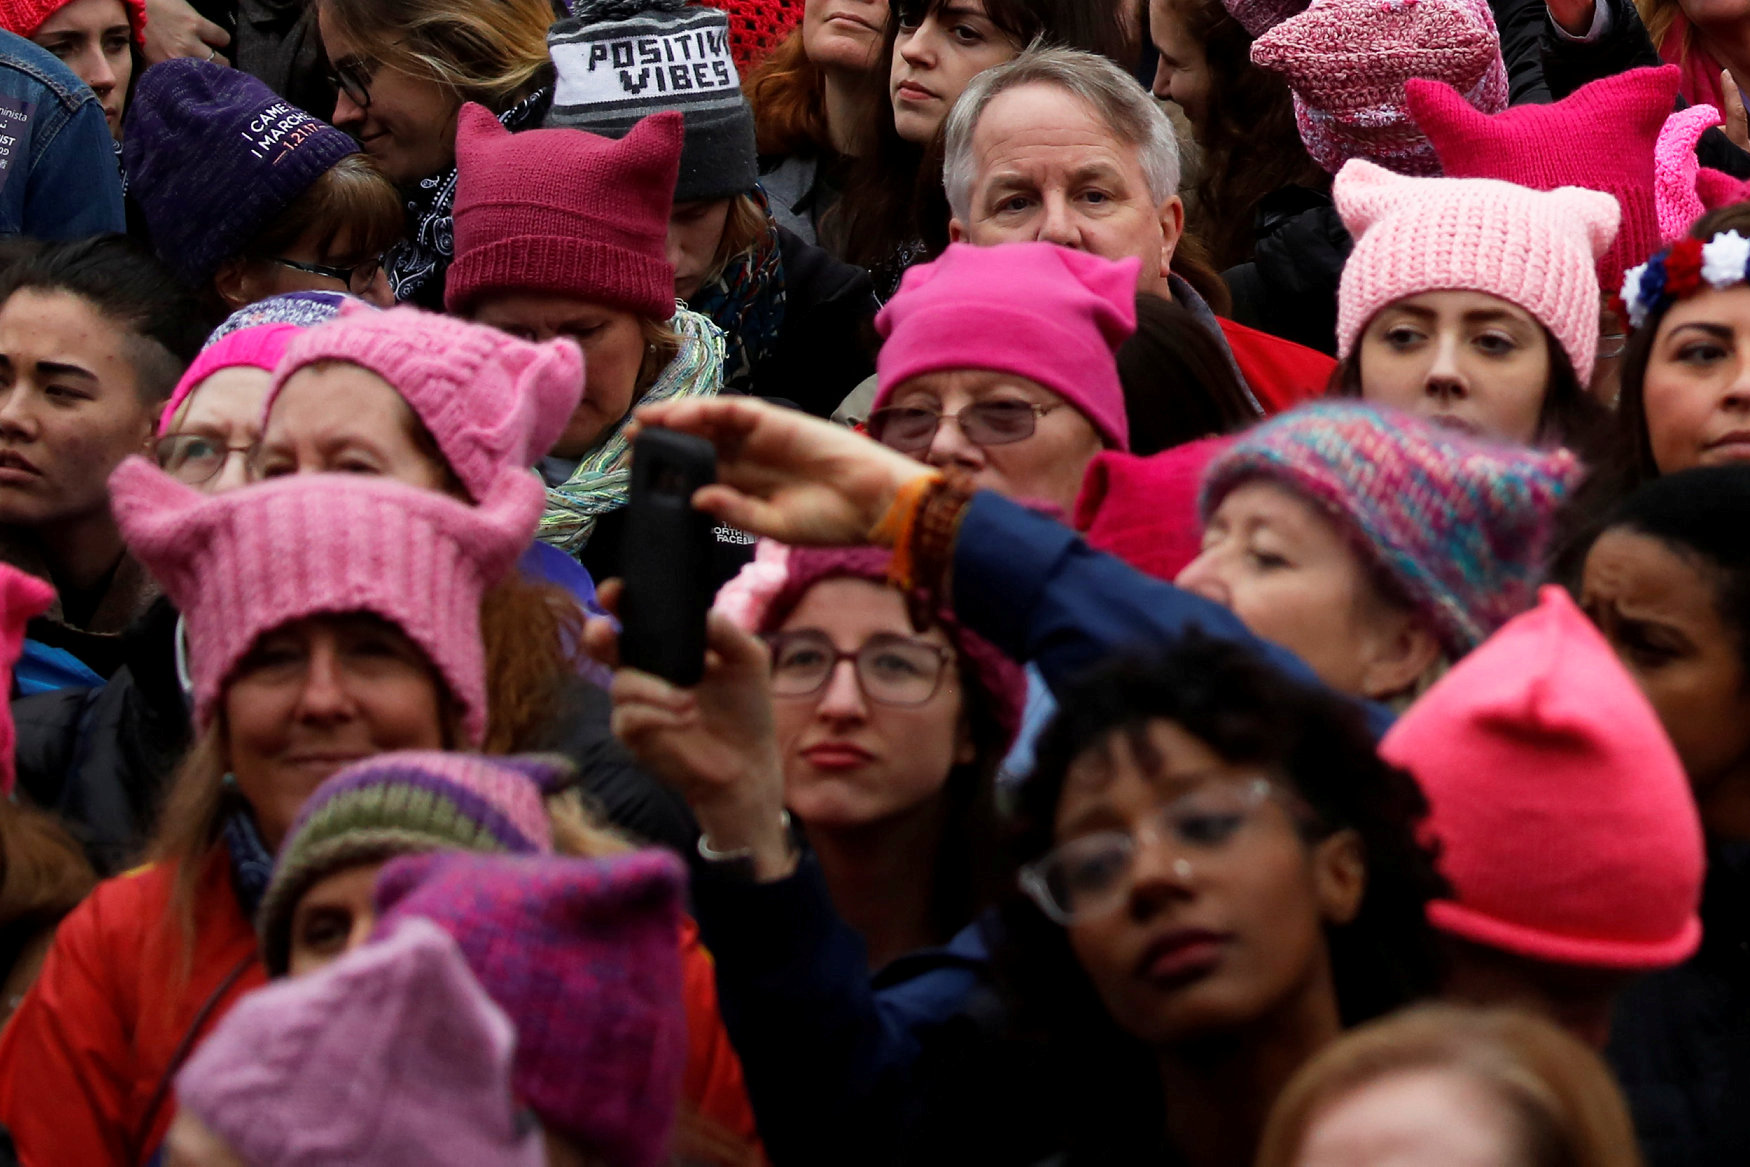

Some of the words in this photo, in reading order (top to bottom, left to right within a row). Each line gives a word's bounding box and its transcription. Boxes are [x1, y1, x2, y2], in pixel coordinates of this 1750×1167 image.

[619, 60, 730, 94] VIBES
[250, 102, 290, 133] CAME
[711, 526, 743, 537] ORTH
[716, 534, 744, 545] FACE
